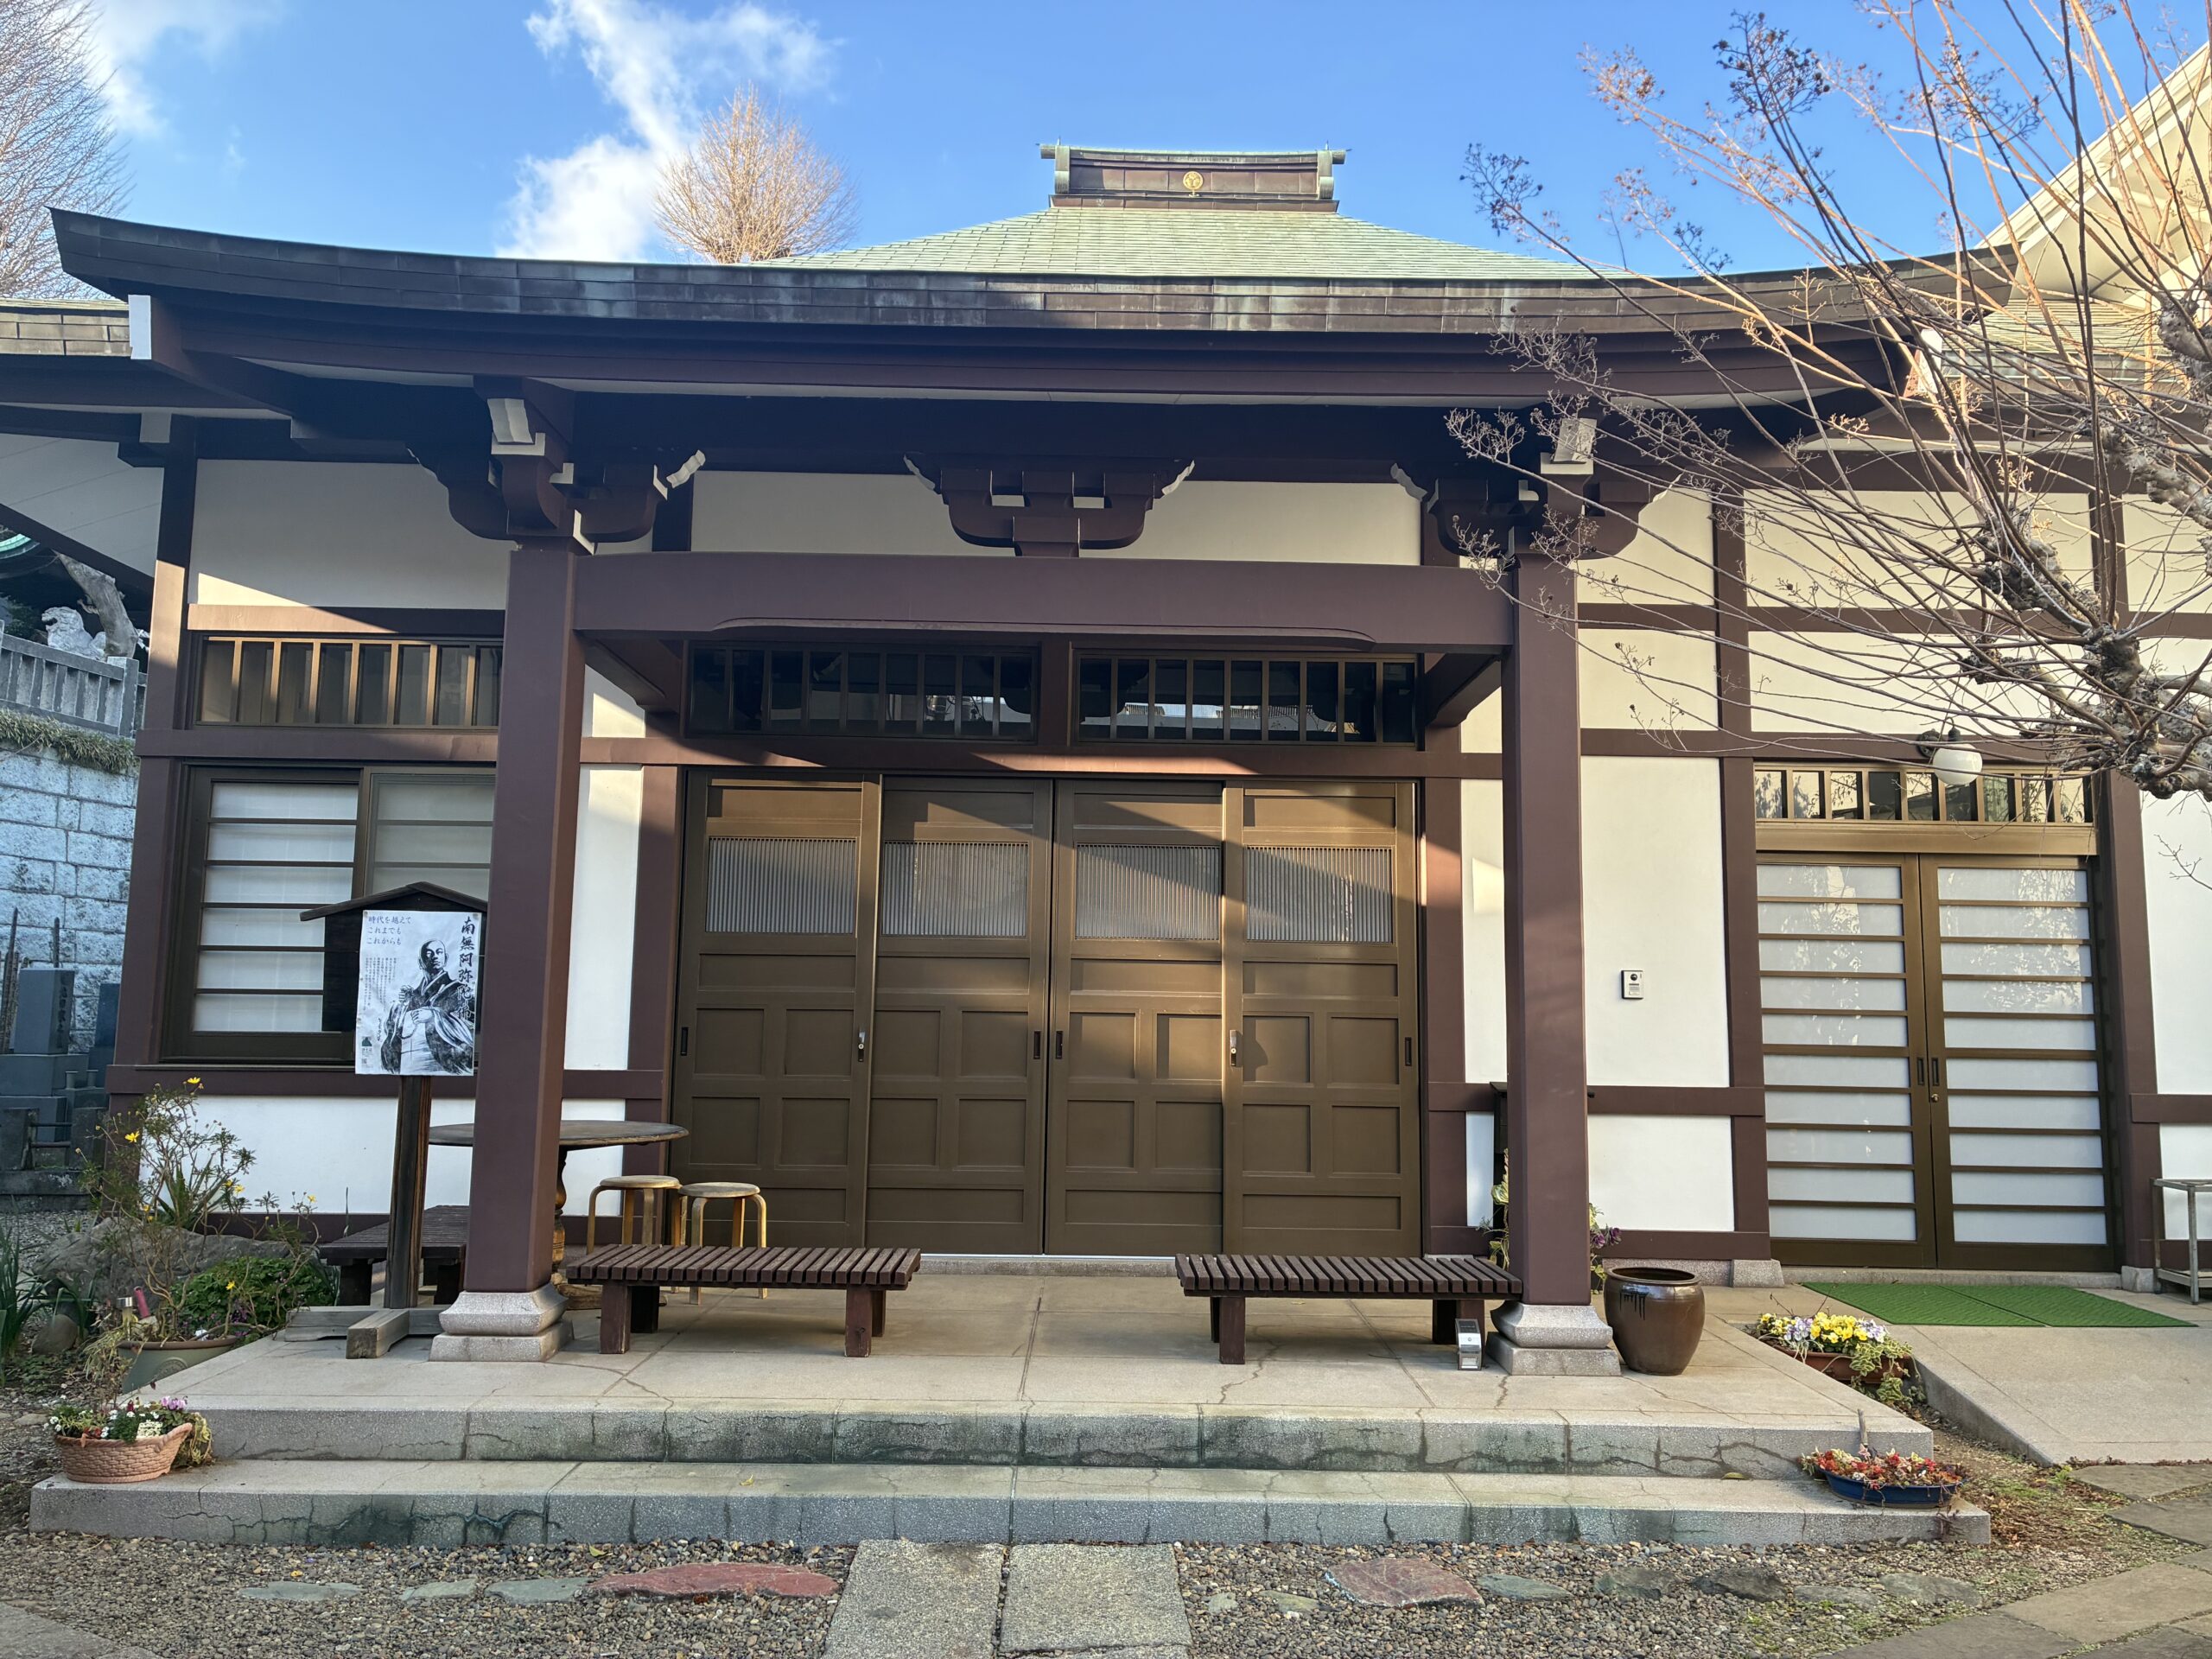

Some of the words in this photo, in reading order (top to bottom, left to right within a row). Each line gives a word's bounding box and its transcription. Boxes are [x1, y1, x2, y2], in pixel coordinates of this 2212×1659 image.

[365, 926, 402, 935] これまでも
[365, 937, 402, 945] これからも
